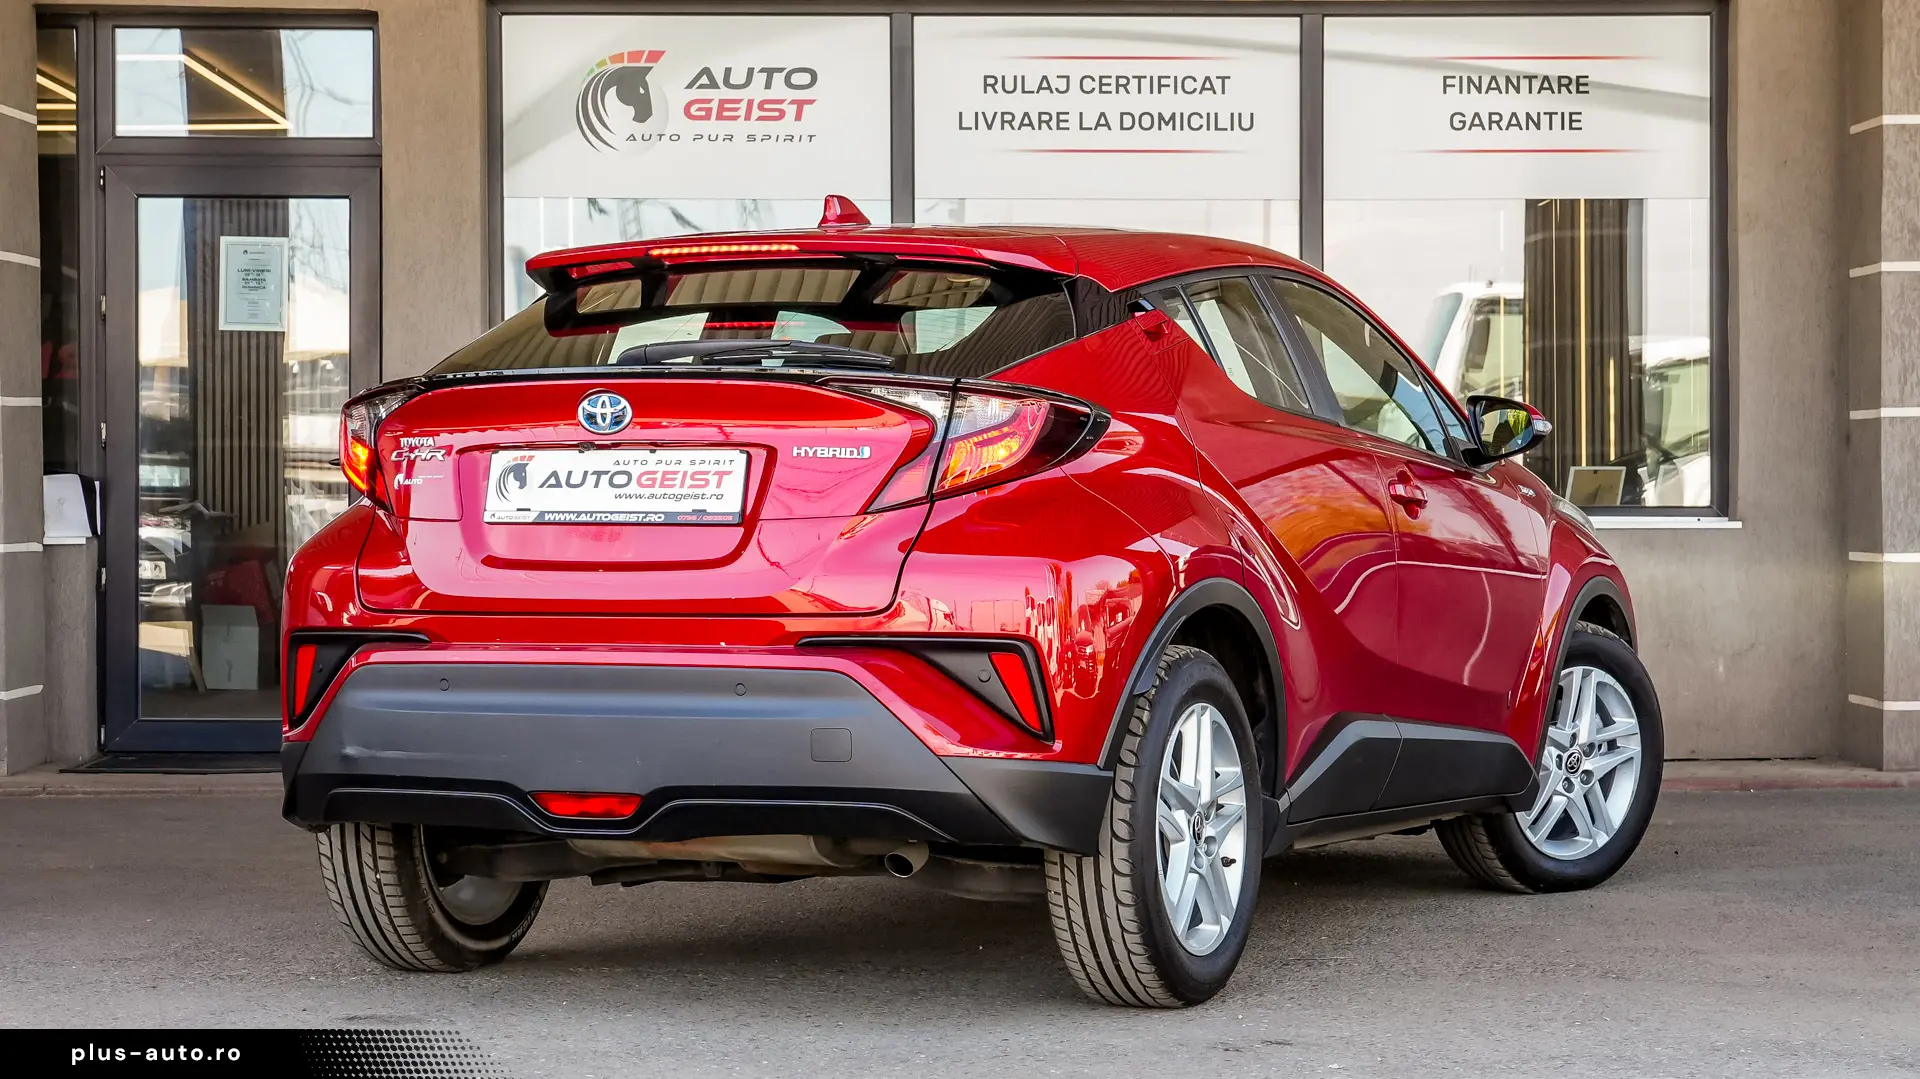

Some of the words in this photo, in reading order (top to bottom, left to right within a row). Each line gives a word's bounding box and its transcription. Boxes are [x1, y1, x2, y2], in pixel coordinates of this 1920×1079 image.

[683, 66, 818, 91] AUTO
[983, 74, 1071, 95] RULAJ
[1079, 74, 1231, 95] CERTIFICAT
[1442, 74, 1591, 95] FINANTARE
[683, 98, 817, 122] GEIST
[958, 111, 1070, 132] LIVRARE
[1079, 111, 1112, 132] LA
[1119, 111, 1254, 132] DOMICILIU
[1449, 111, 1583, 131] GARANTIE
[625, 133, 681, 143] AUTO
[692, 133, 734, 143] PUR
[746, 133, 817, 143] SPIRIT
[400, 437, 435, 448] TOYOTA
[391, 448, 446, 461] C-HR
[792, 446, 858, 458] HYBRID
[614, 491, 724, 502] www.autogeist.ro
[544, 512, 665, 522] WWW.AUTOGEIST.RO
